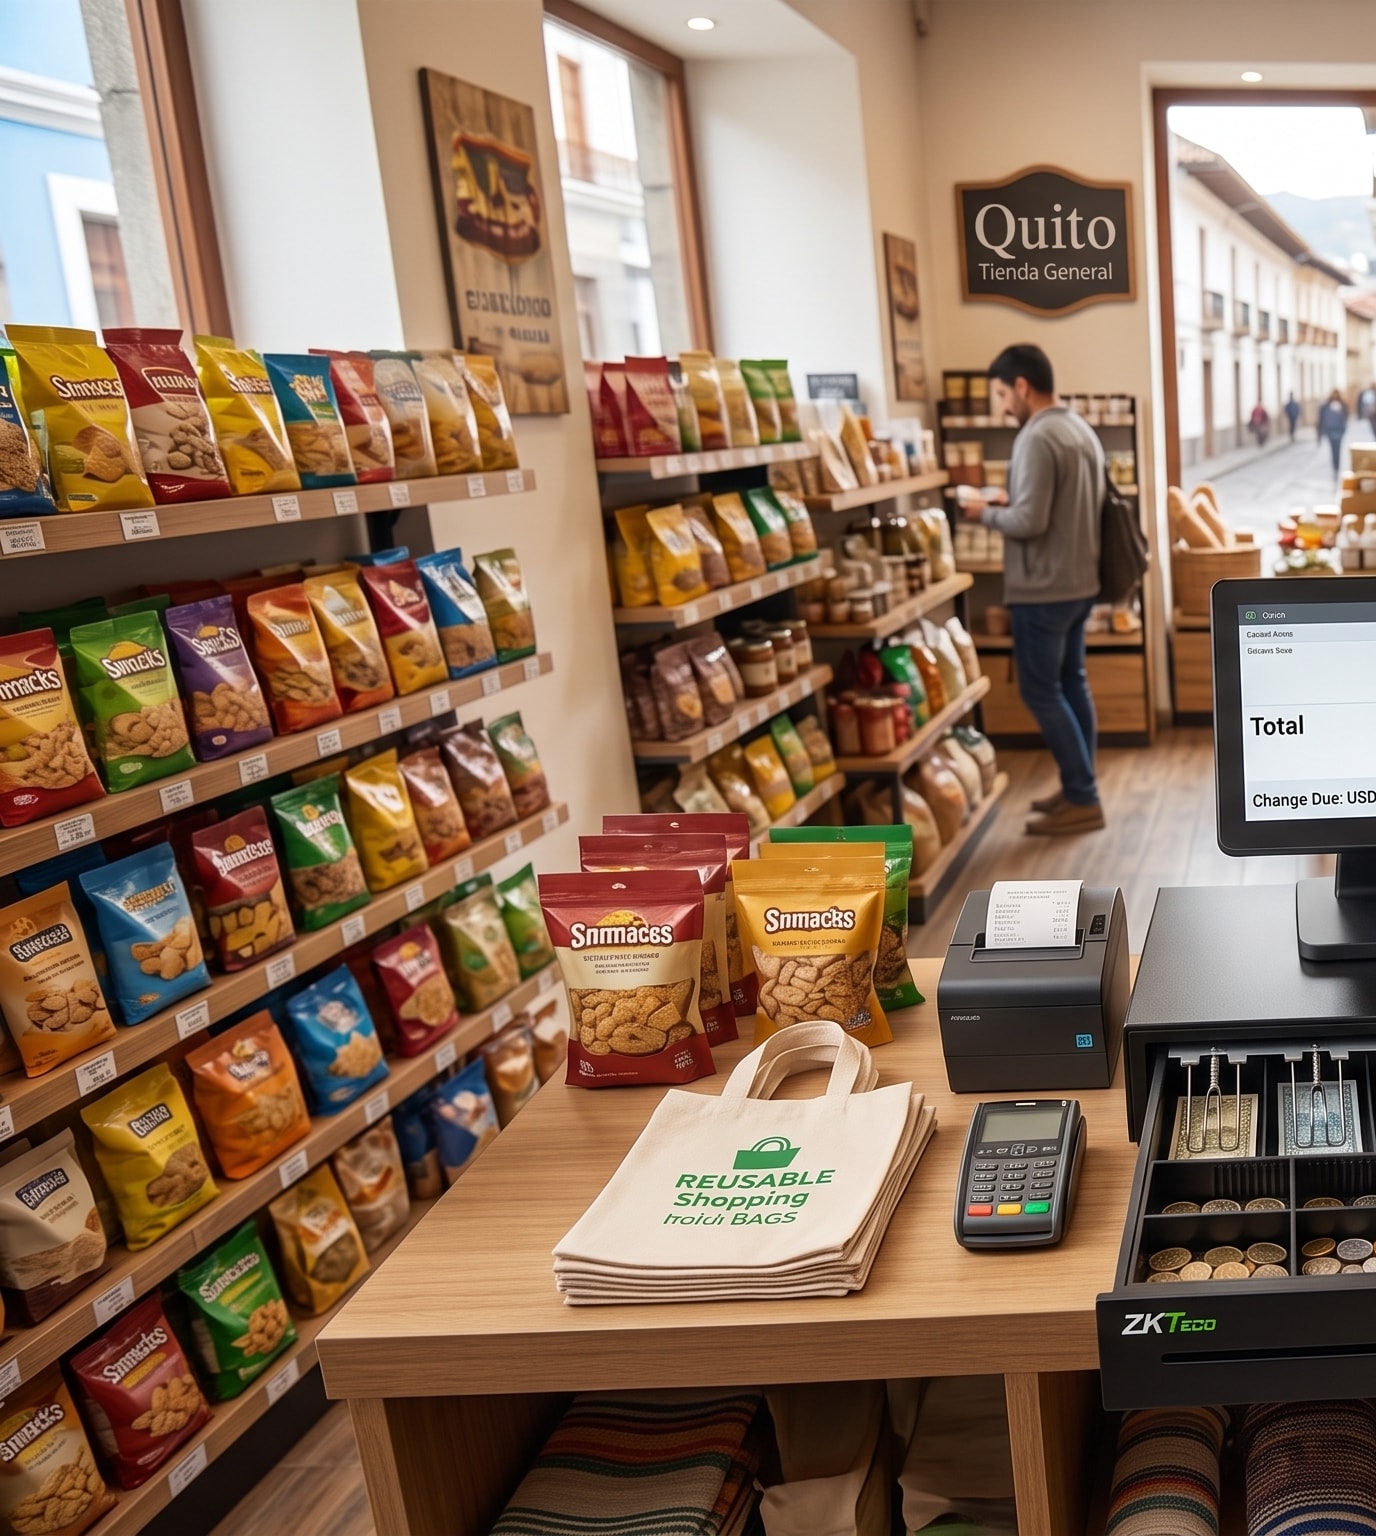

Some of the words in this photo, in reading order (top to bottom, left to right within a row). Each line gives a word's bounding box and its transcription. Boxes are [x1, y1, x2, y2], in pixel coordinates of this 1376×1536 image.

[975, 203, 1116, 259] Quito
[978, 262, 1039, 280] Tienda
[1044, 262, 1113, 280] General
[1250, 715, 1304, 736] Total
[1252, 793, 1308, 810] Change
[1311, 791, 1344, 806] Due:
[674, 1169, 836, 1189] REUSABLE
[673, 1190, 810, 1211] Shopping
[730, 1211, 799, 1226] BAGS
